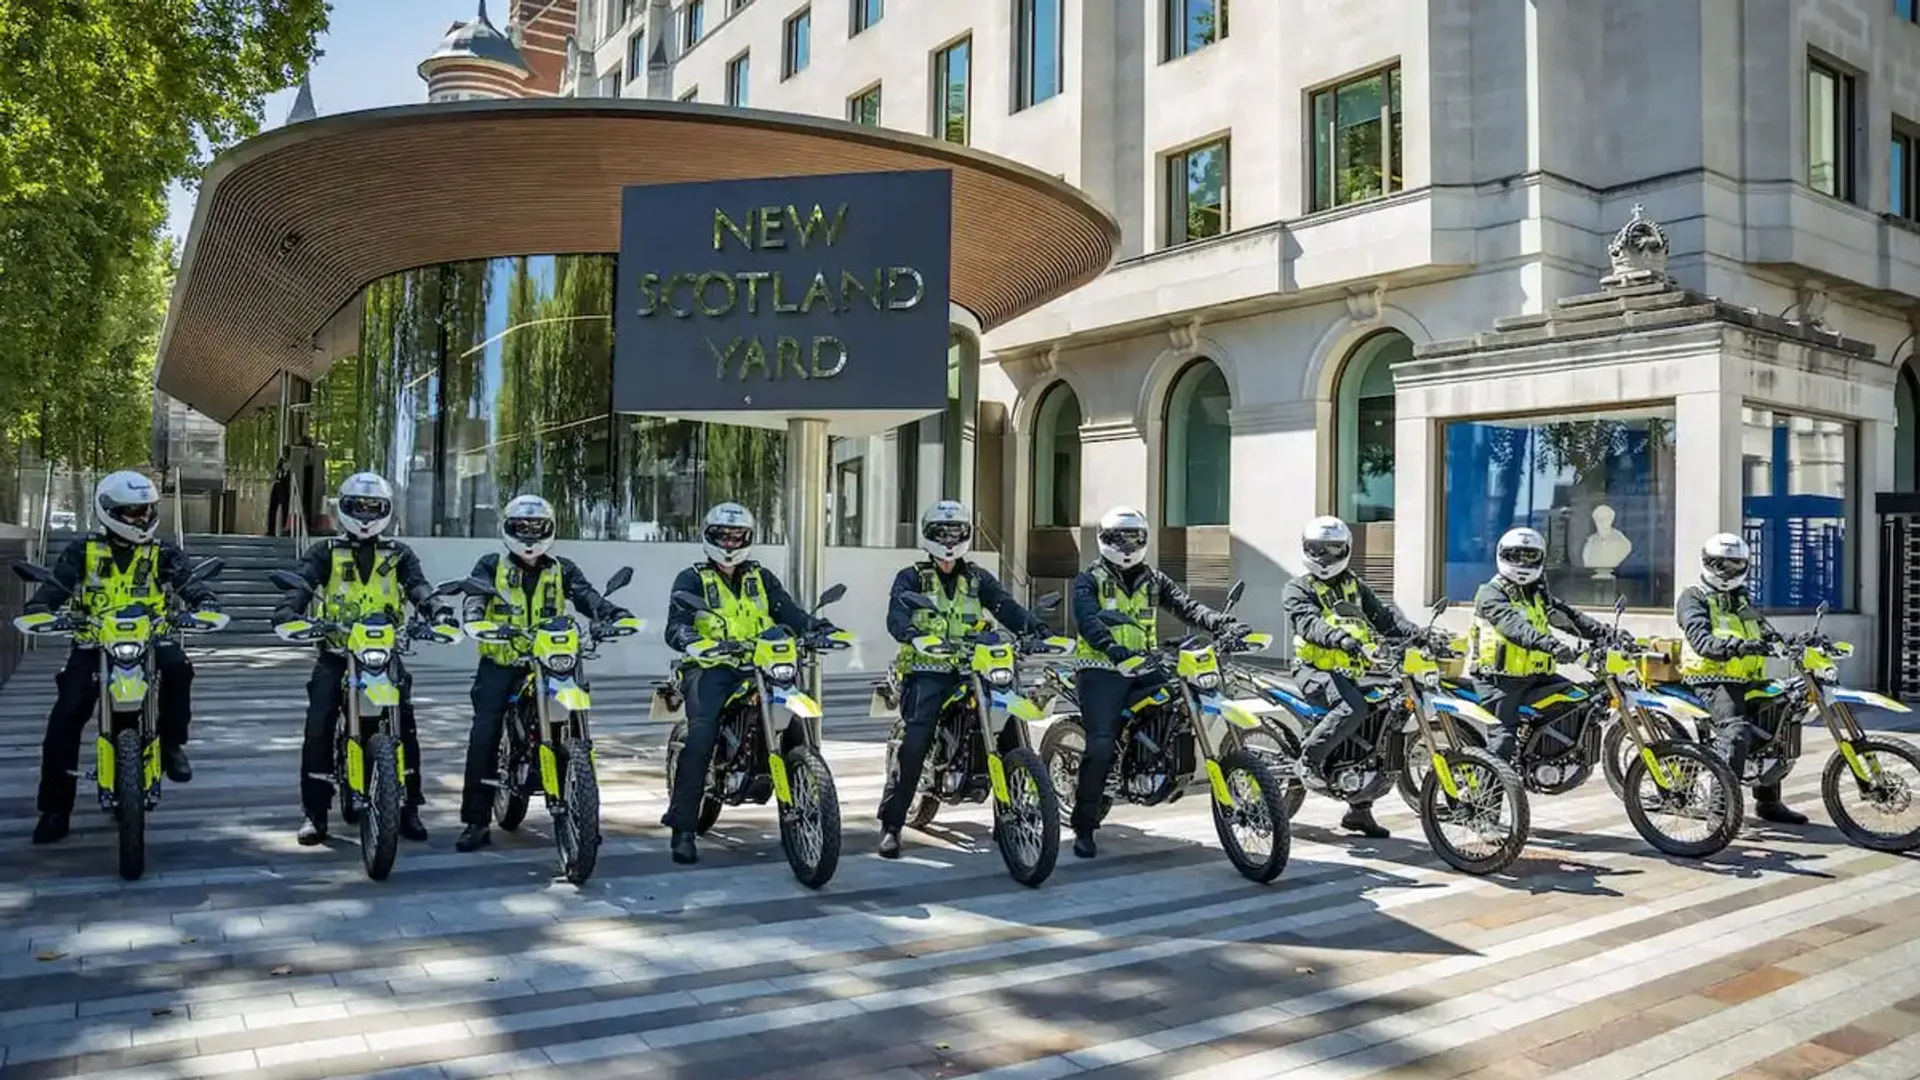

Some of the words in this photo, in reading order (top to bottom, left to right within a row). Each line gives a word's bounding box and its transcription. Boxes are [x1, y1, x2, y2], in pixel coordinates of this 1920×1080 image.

[713, 202, 848, 250] NEW
[638, 267, 924, 317] SCOTLAND
[704, 335, 847, 380] YARD
